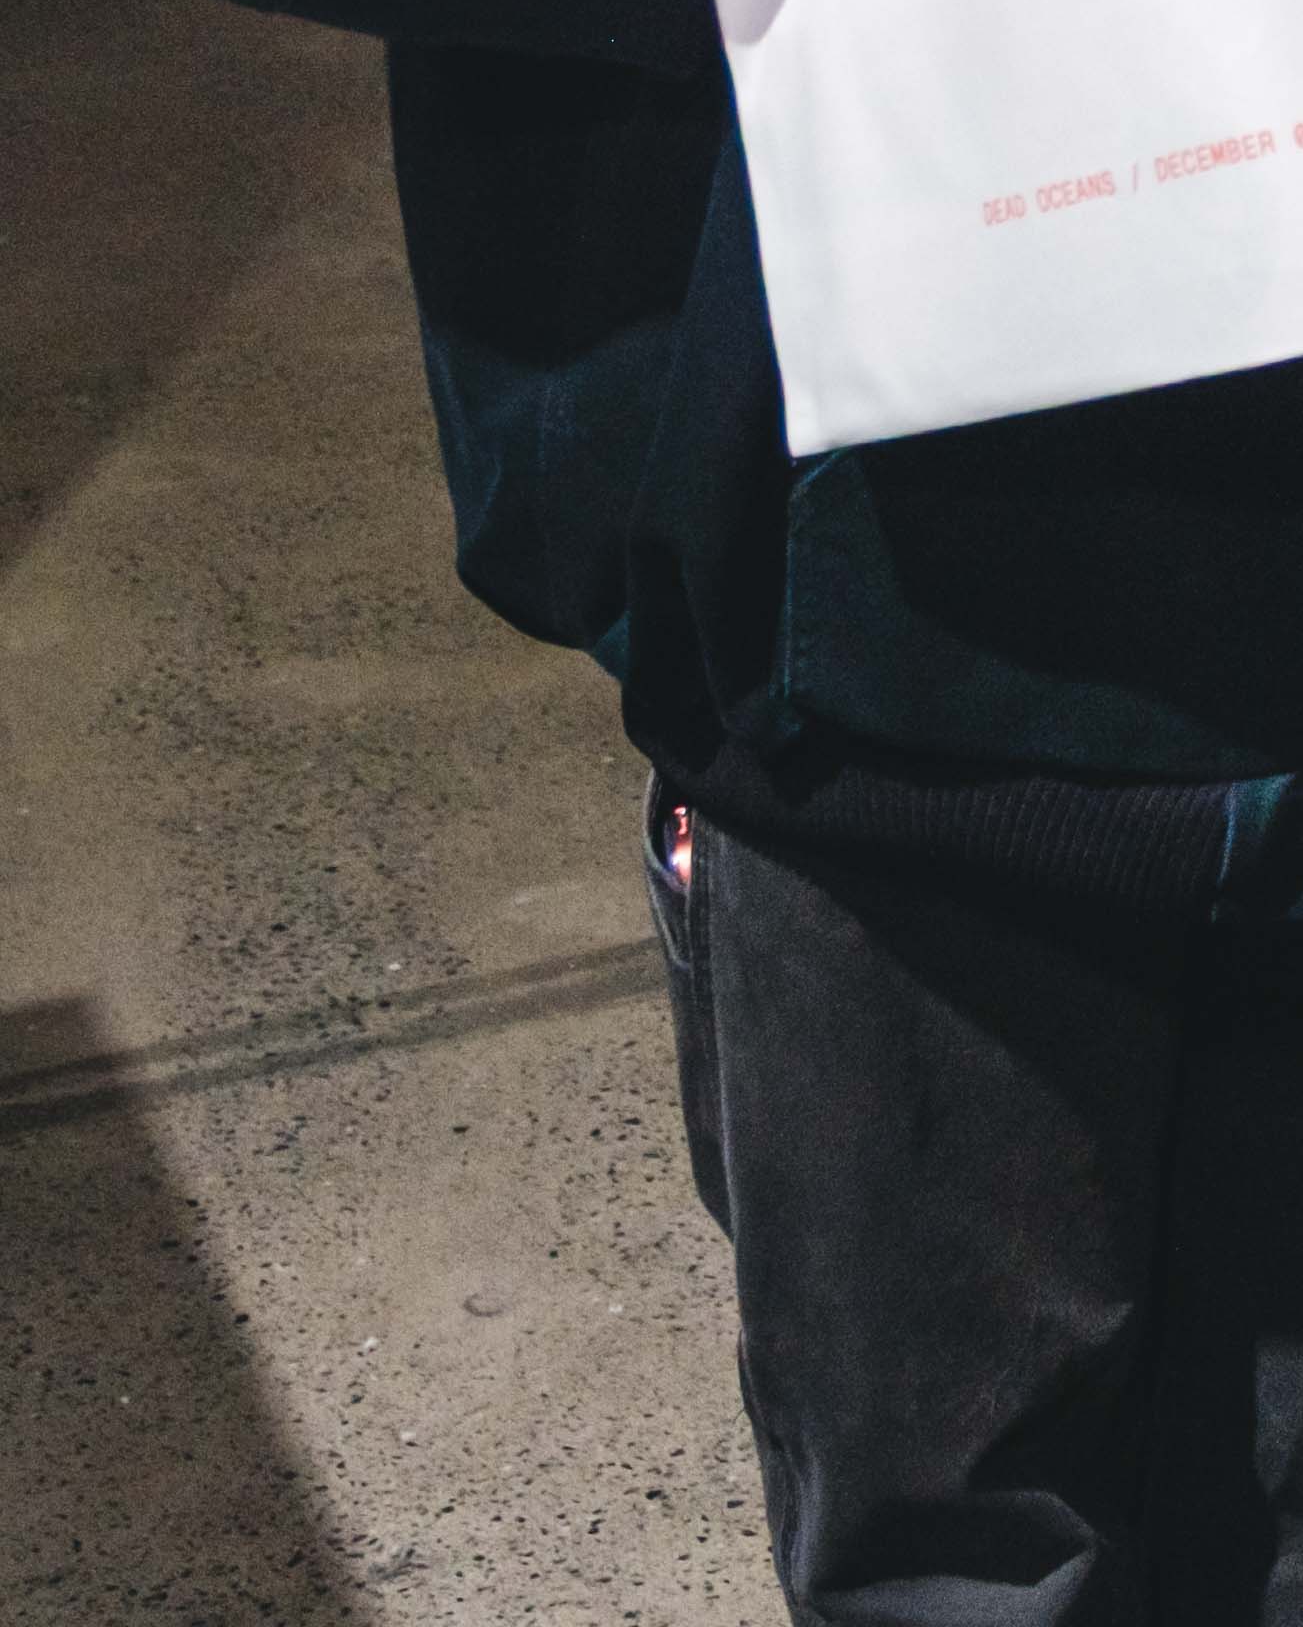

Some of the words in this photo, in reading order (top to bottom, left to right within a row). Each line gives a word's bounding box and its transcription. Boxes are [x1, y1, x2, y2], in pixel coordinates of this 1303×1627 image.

[982, 194, 1026, 227] DEAD
[1035, 171, 1116, 214] OCEANS
[1154, 129, 1275, 184] DECEMBER
